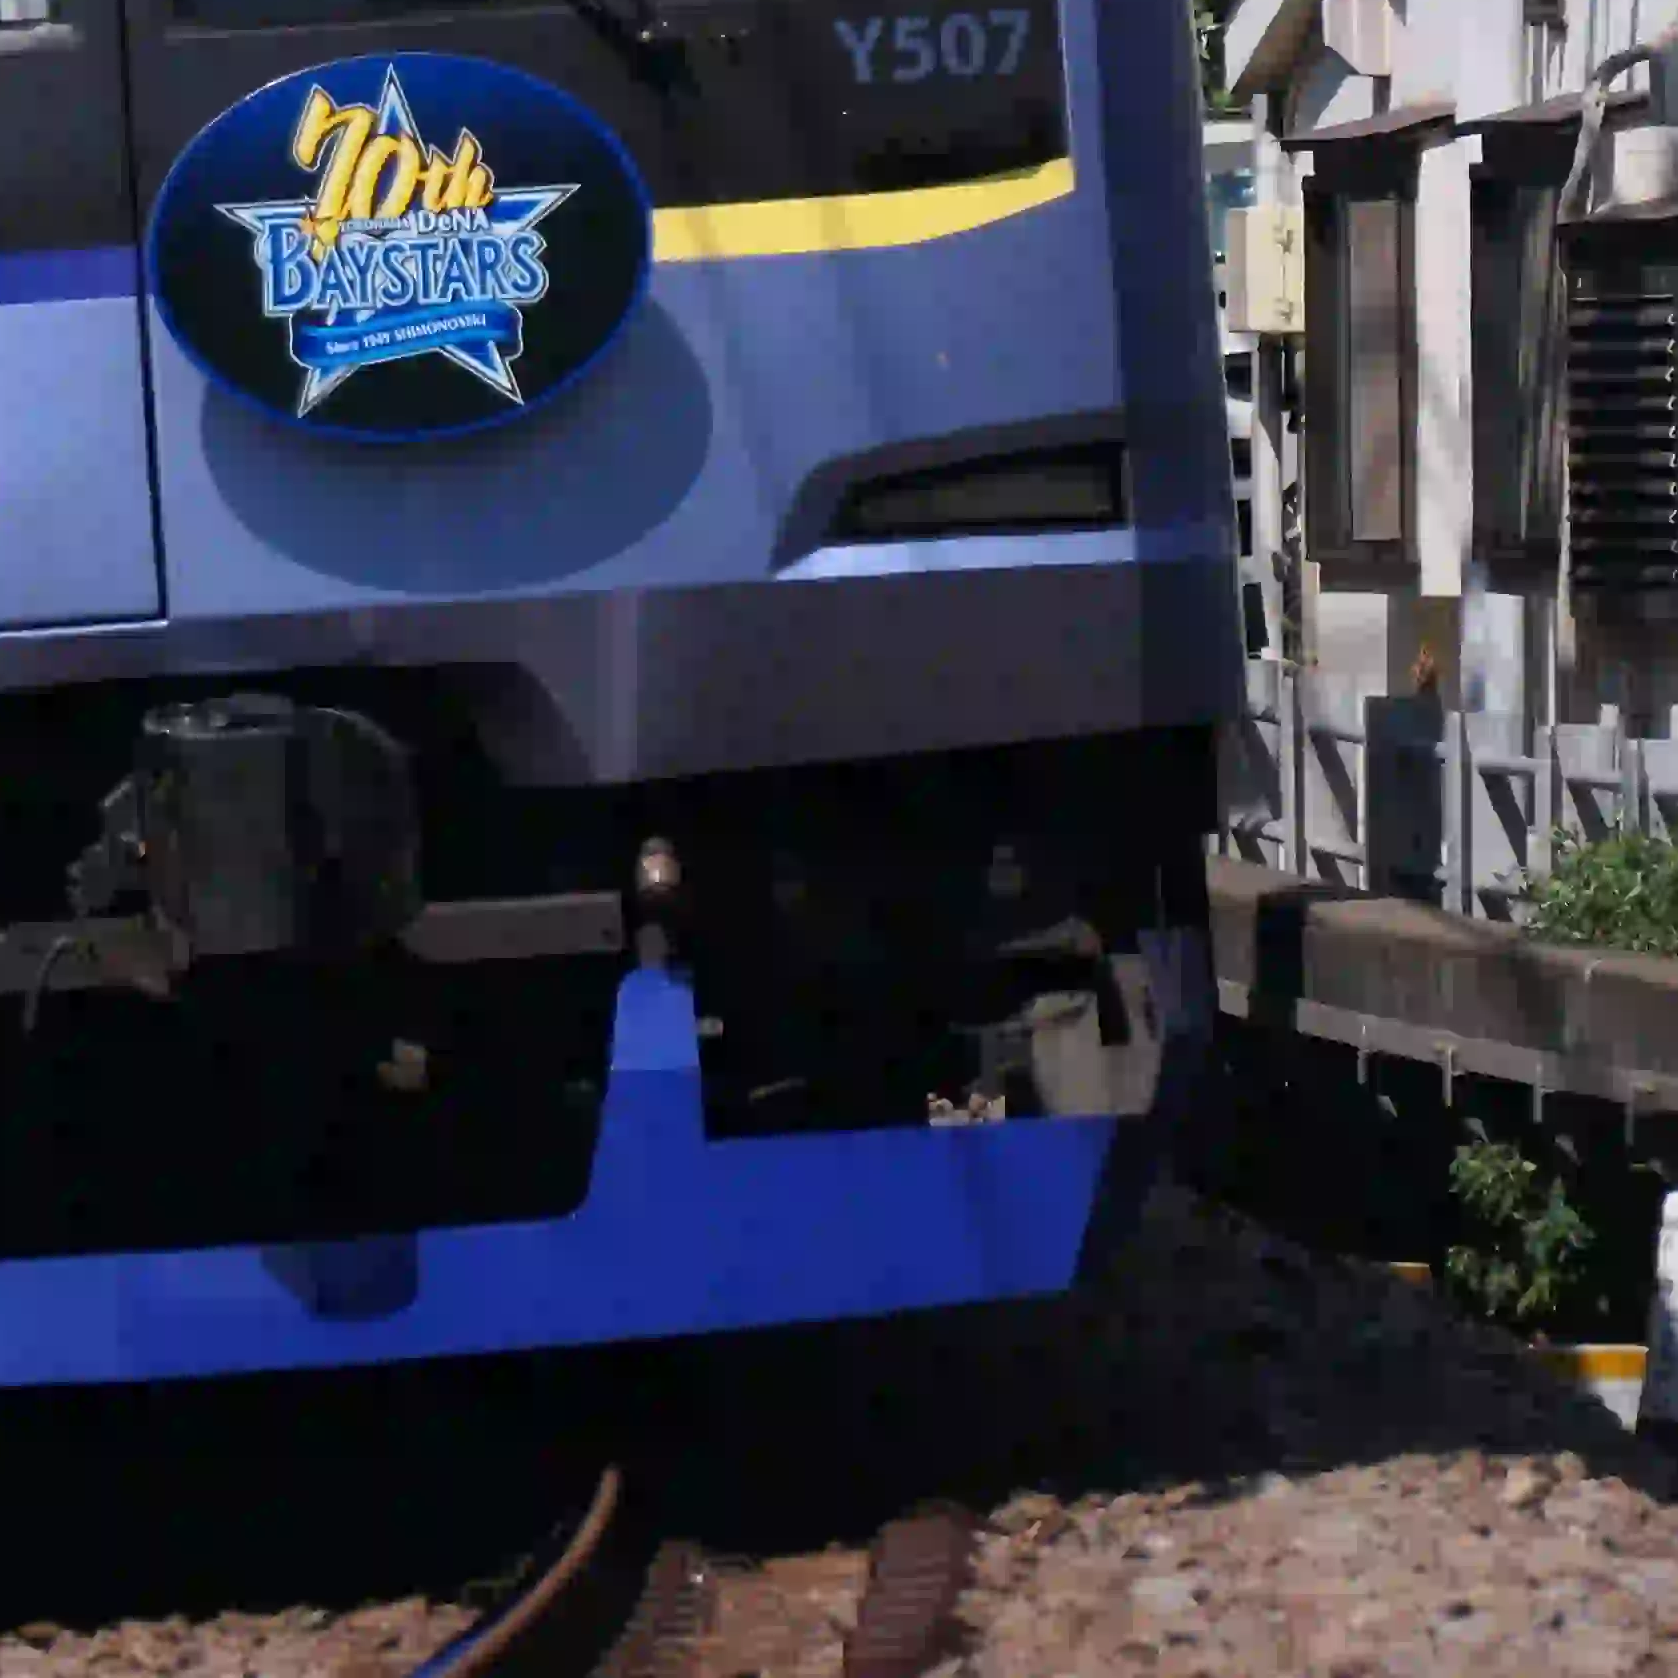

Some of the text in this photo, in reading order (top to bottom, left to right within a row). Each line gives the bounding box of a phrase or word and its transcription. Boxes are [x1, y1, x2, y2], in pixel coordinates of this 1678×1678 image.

[833, 8, 1031, 83] Y507
[294, 84, 495, 220] 70th
[263, 218, 548, 312] BAYSTARS
